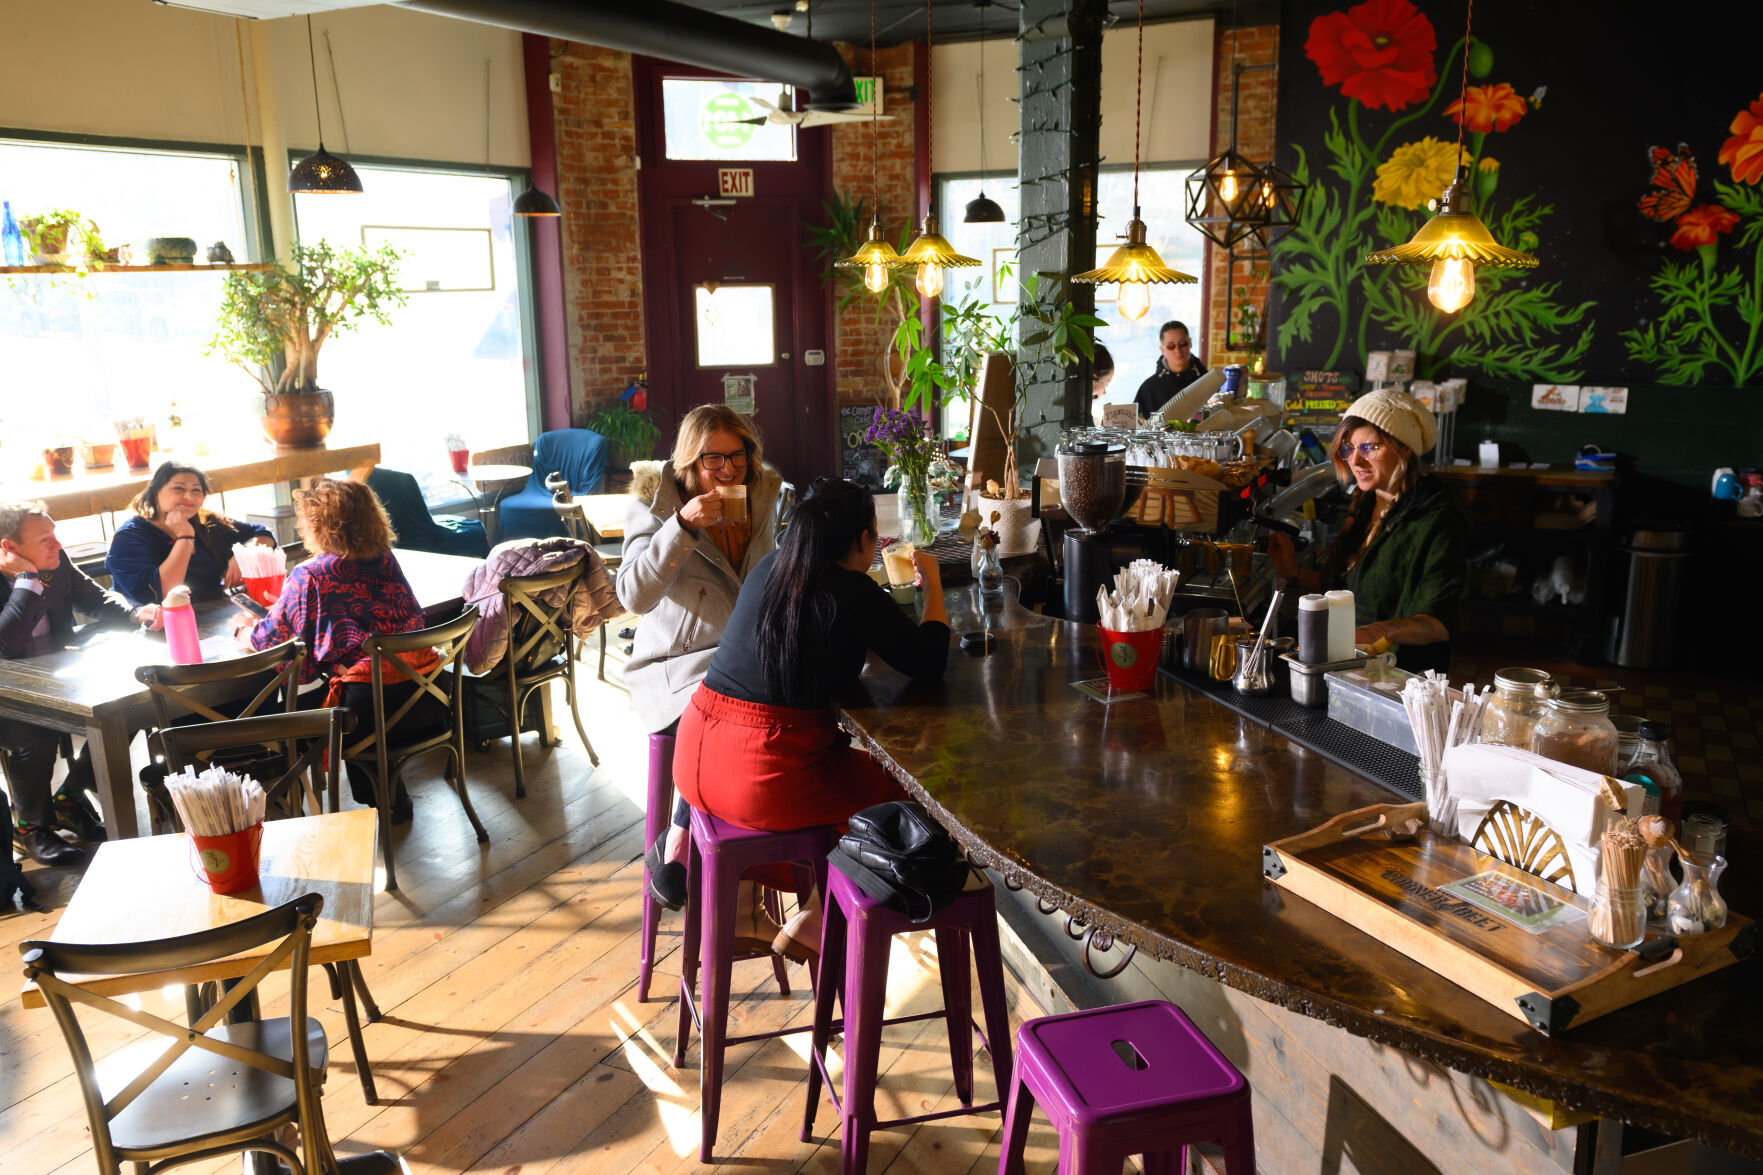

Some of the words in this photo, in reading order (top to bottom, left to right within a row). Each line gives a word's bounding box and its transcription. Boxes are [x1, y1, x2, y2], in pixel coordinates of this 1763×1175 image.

[855, 80, 876, 103] XIT
[721, 171, 751, 194] EXIT
[1304, 370, 1340, 384] SHOTS
